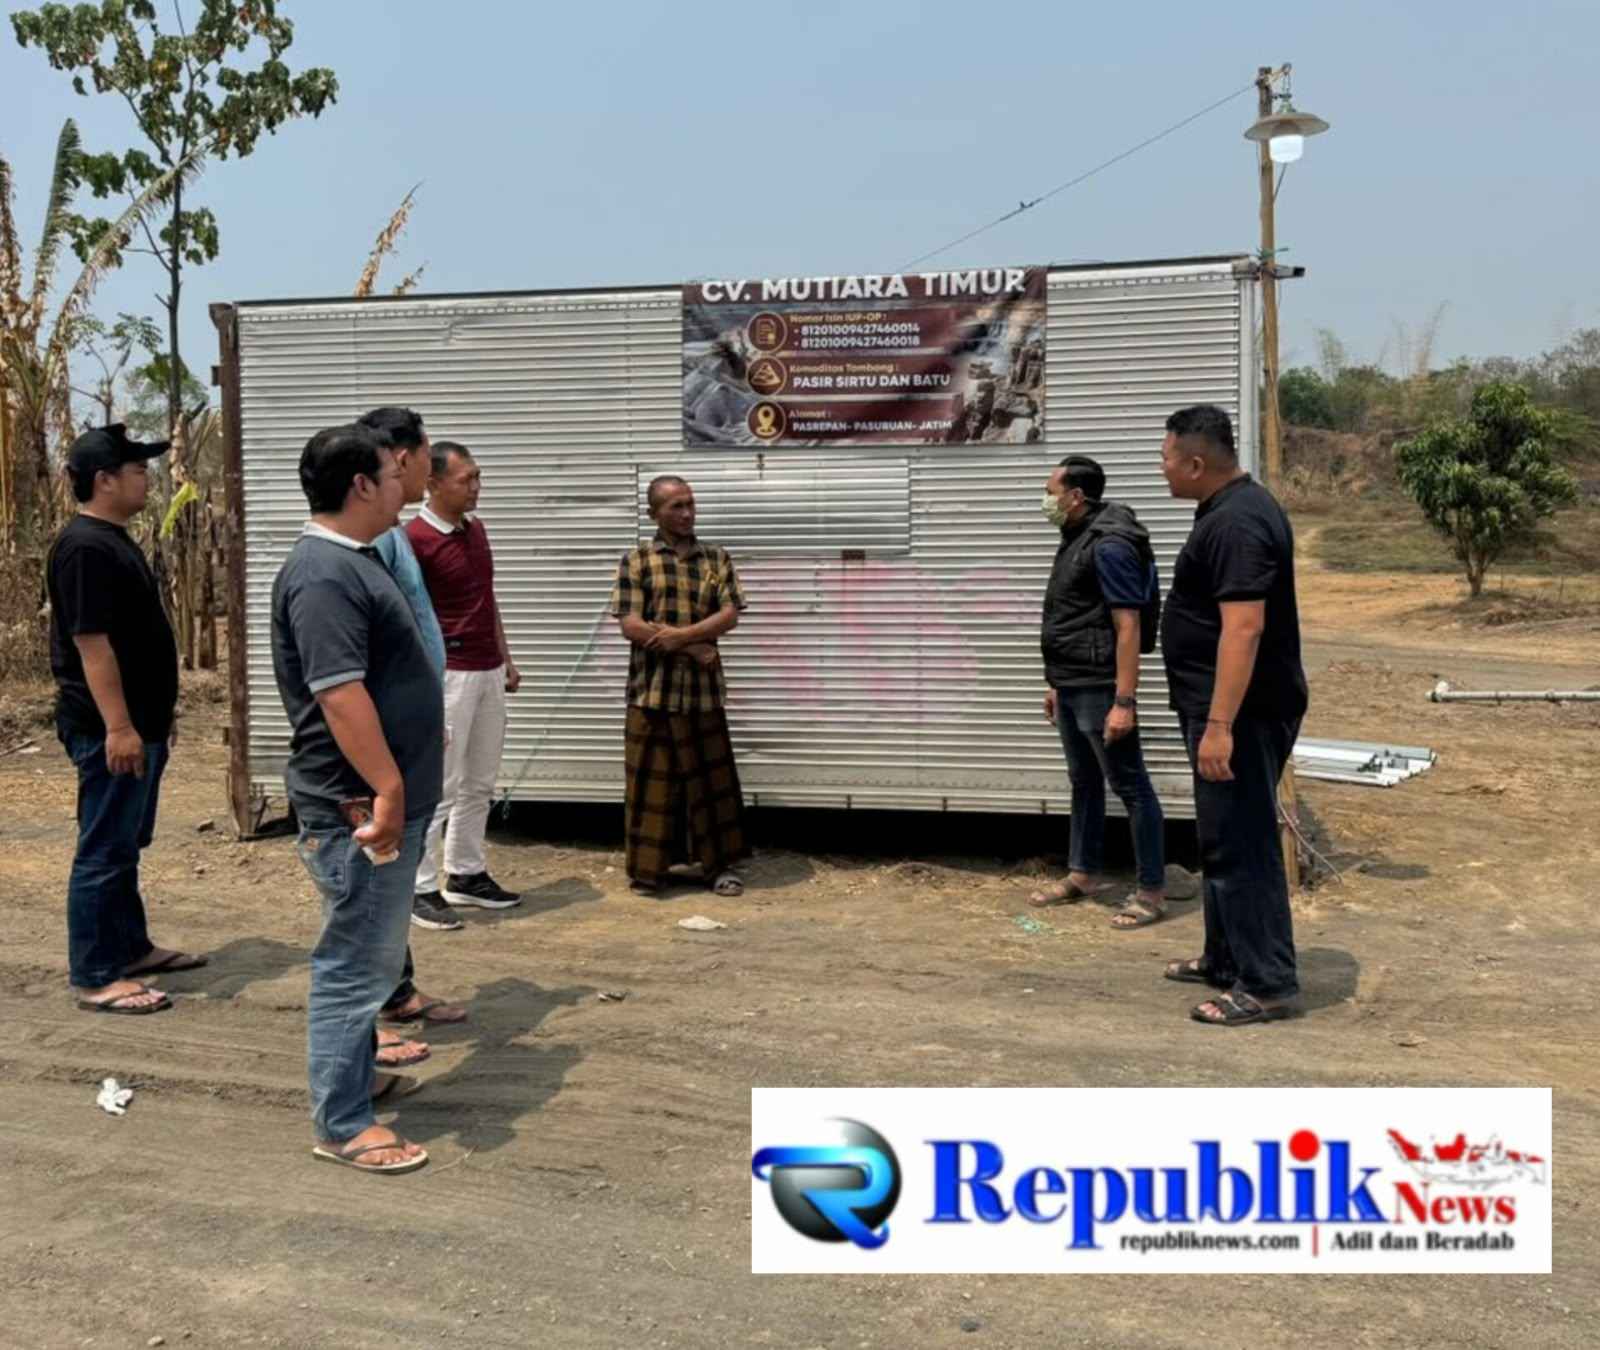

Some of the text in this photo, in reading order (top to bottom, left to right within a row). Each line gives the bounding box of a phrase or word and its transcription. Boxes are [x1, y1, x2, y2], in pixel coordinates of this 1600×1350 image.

[701, 268, 1026, 302] CV. MUTIARA TIMUR
[793, 374, 950, 388] PASIR SIRTU DAN BATU
